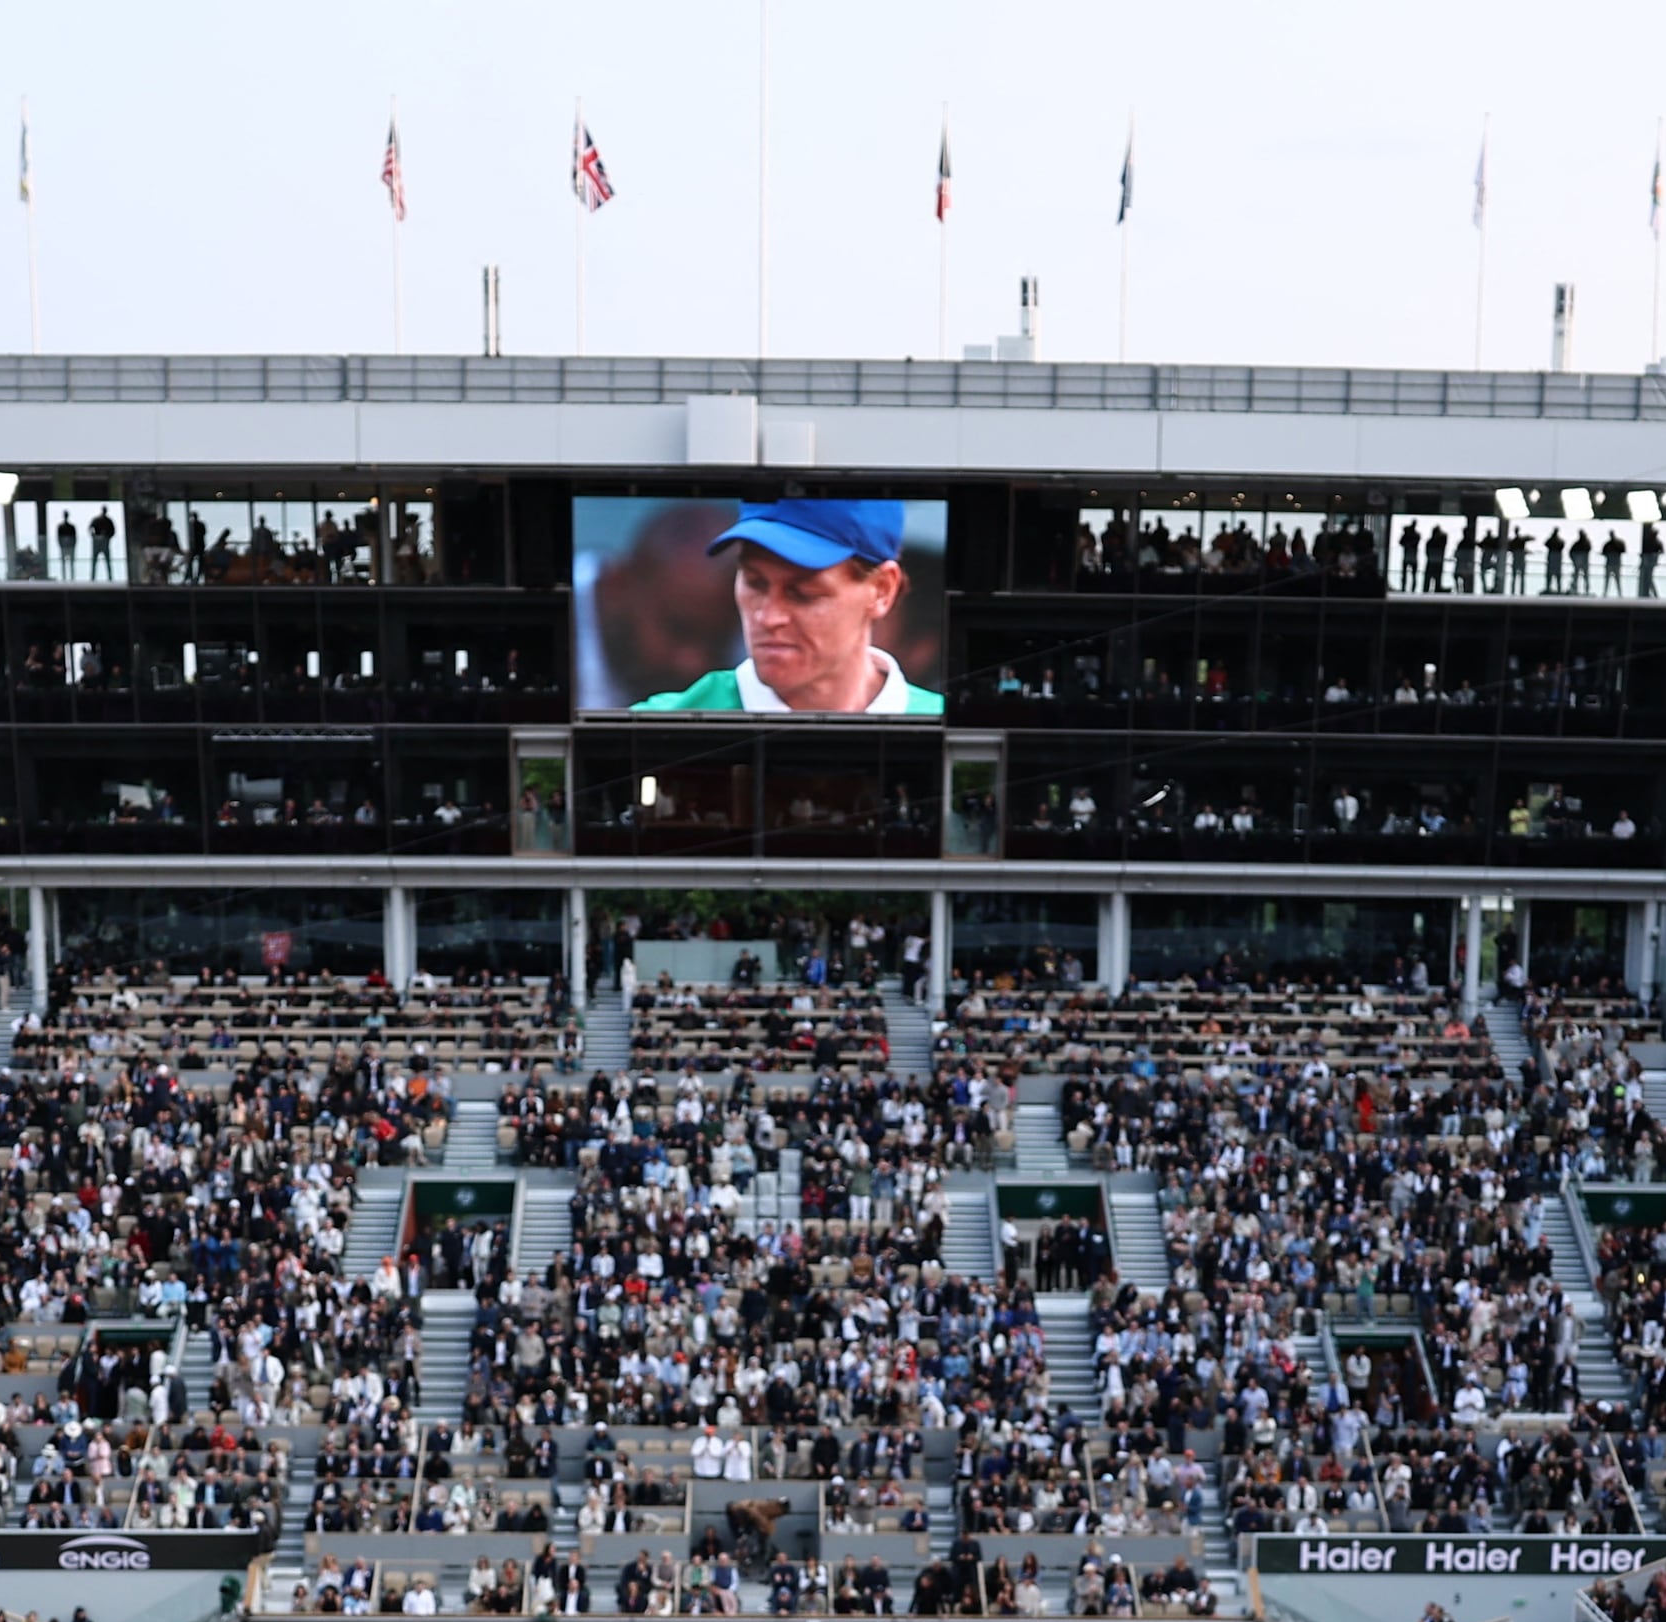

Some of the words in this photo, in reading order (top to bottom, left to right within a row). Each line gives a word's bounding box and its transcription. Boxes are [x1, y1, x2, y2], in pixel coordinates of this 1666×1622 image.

[1299, 1540, 1396, 1571] Haier
[1426, 1541, 1522, 1572] Haier
[1550, 1541, 1646, 1572] Haier
